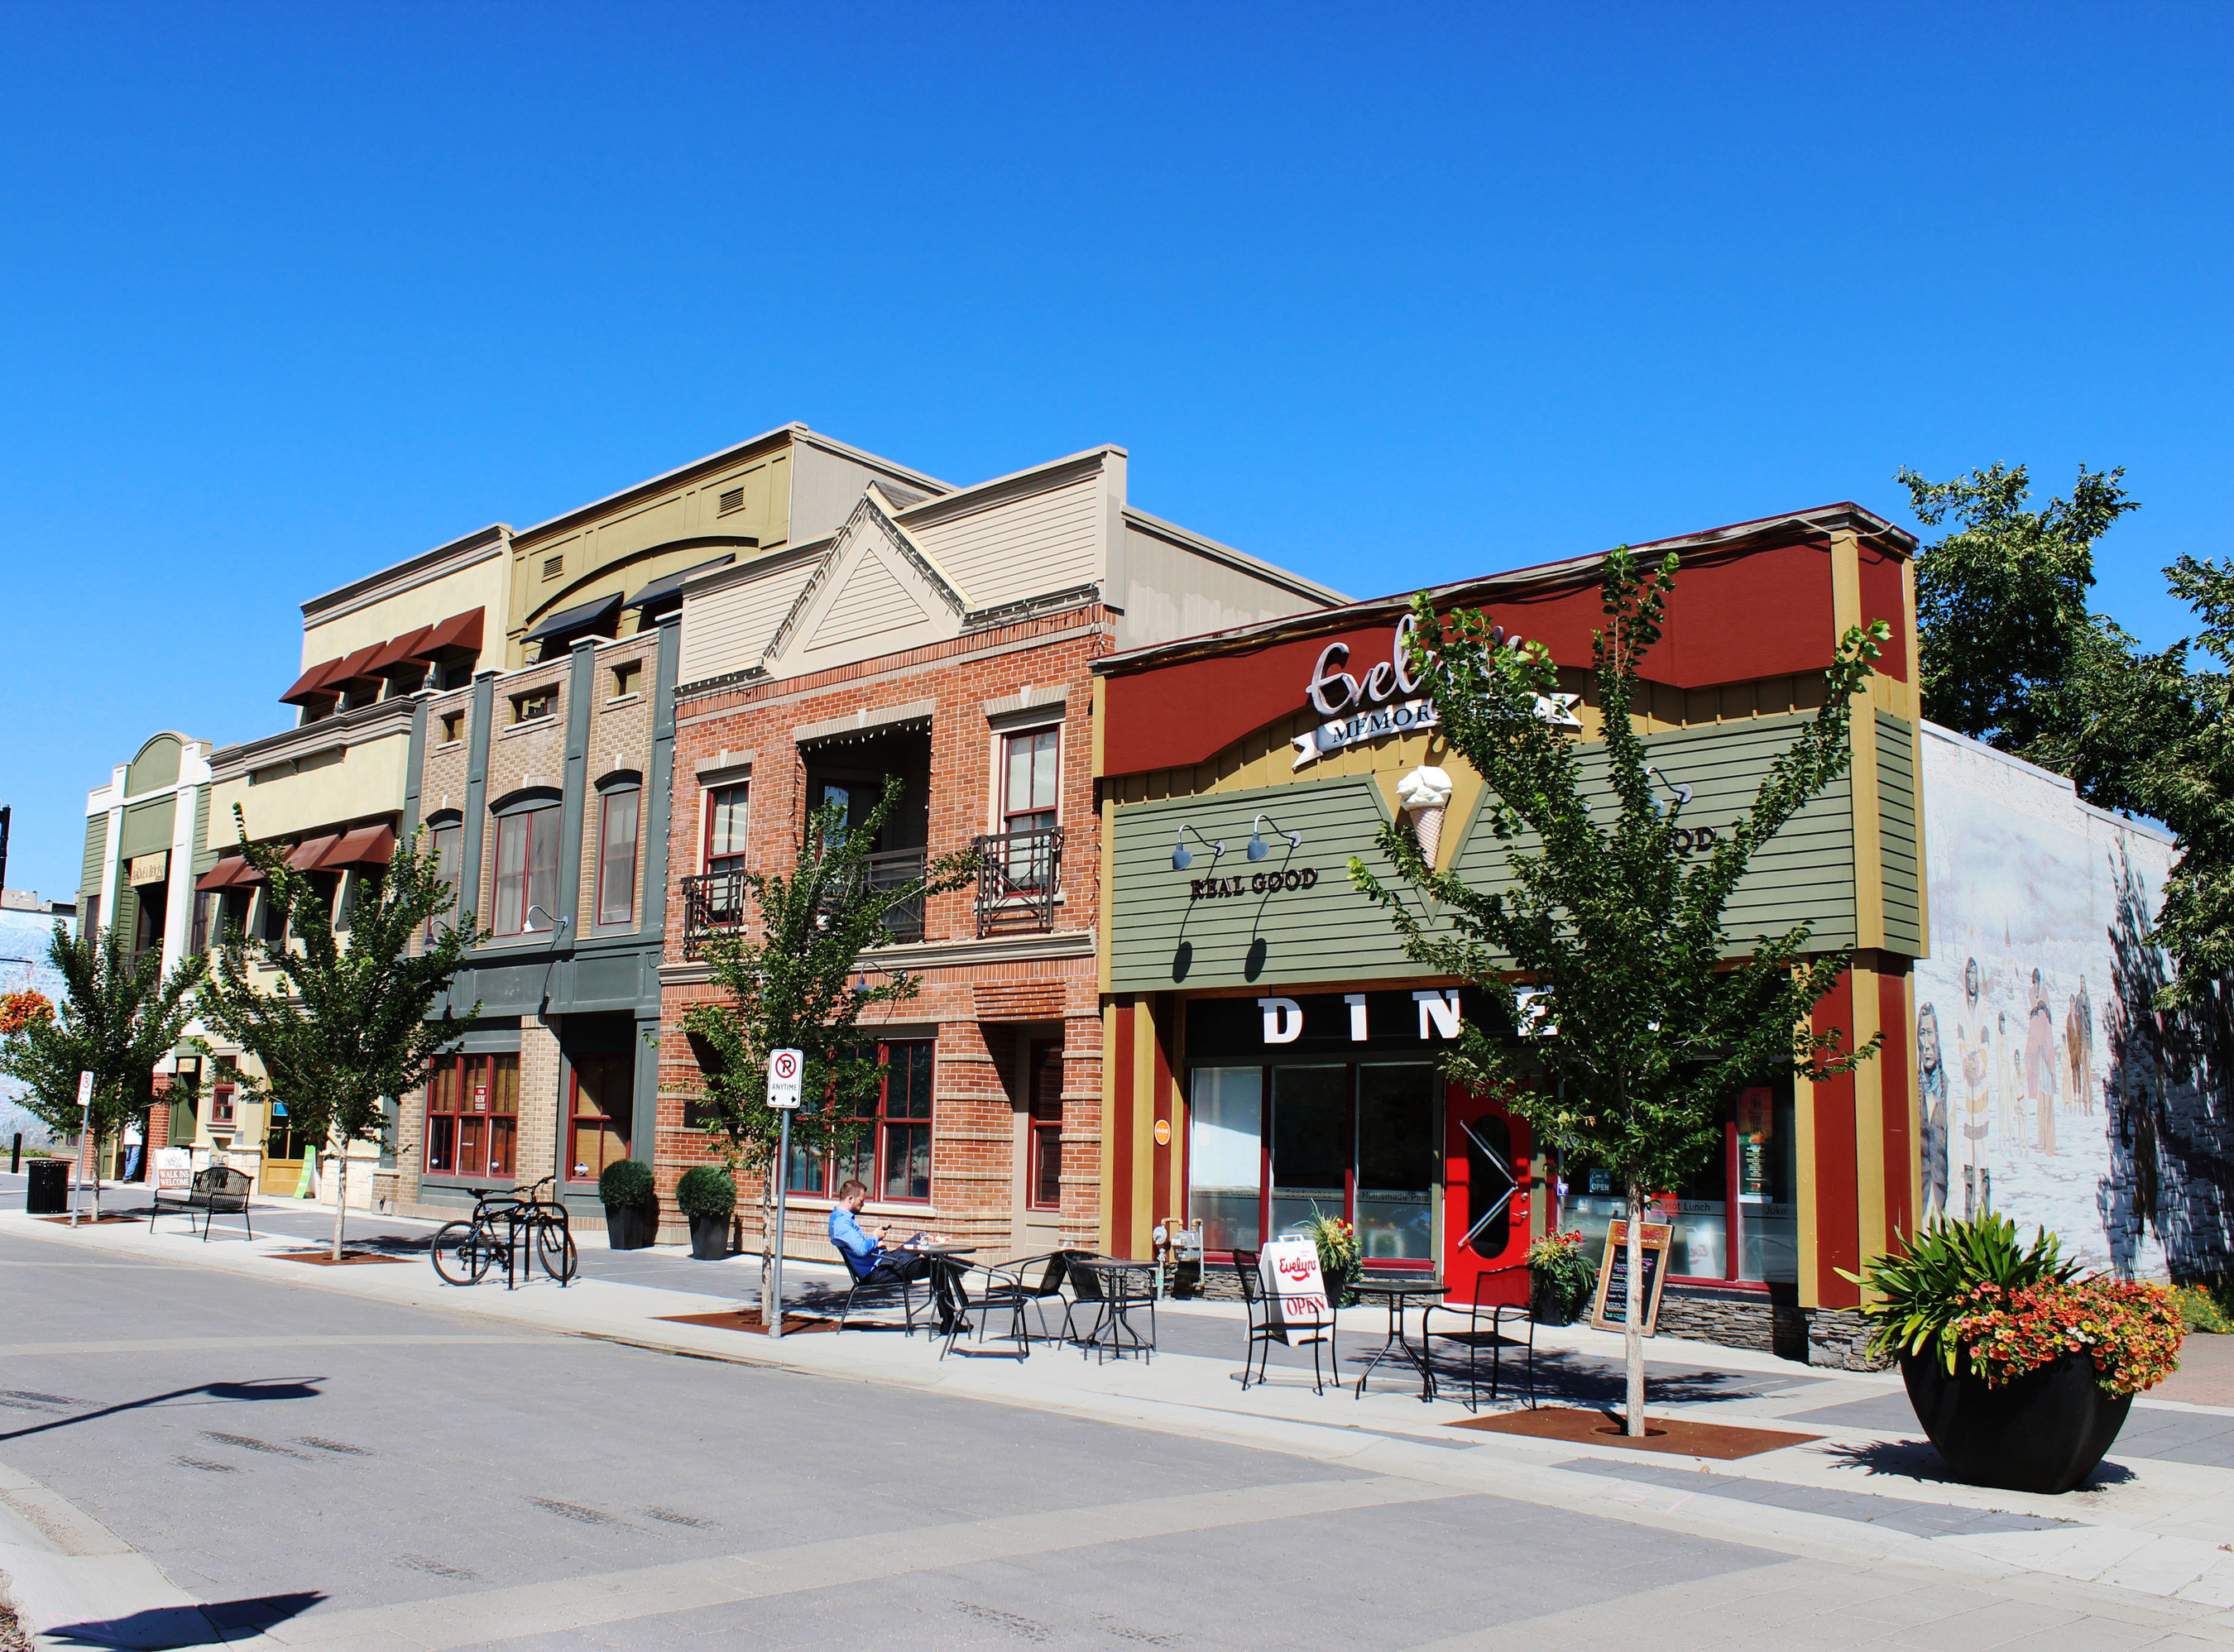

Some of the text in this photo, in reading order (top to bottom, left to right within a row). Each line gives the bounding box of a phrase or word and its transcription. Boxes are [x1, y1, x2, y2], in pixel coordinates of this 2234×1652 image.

[1332, 706, 1436, 744] MEMOR
[1190, 868, 1318, 901] REAL GOOD
[771, 1083, 798, 1091] ANYTIME
[160, 1170, 189, 1178] WALK INS
[1591, 1183, 1609, 1191] OPEN
[1285, 1189, 1331, 1199] Sandwiches
[1362, 1191, 1429, 1202] Homemade Pies
[1665, 1202, 1710, 1212] Hot Lunch
[1279, 1257, 1316, 1281] Evelyns
[1287, 1295, 1326, 1316] OPEN
